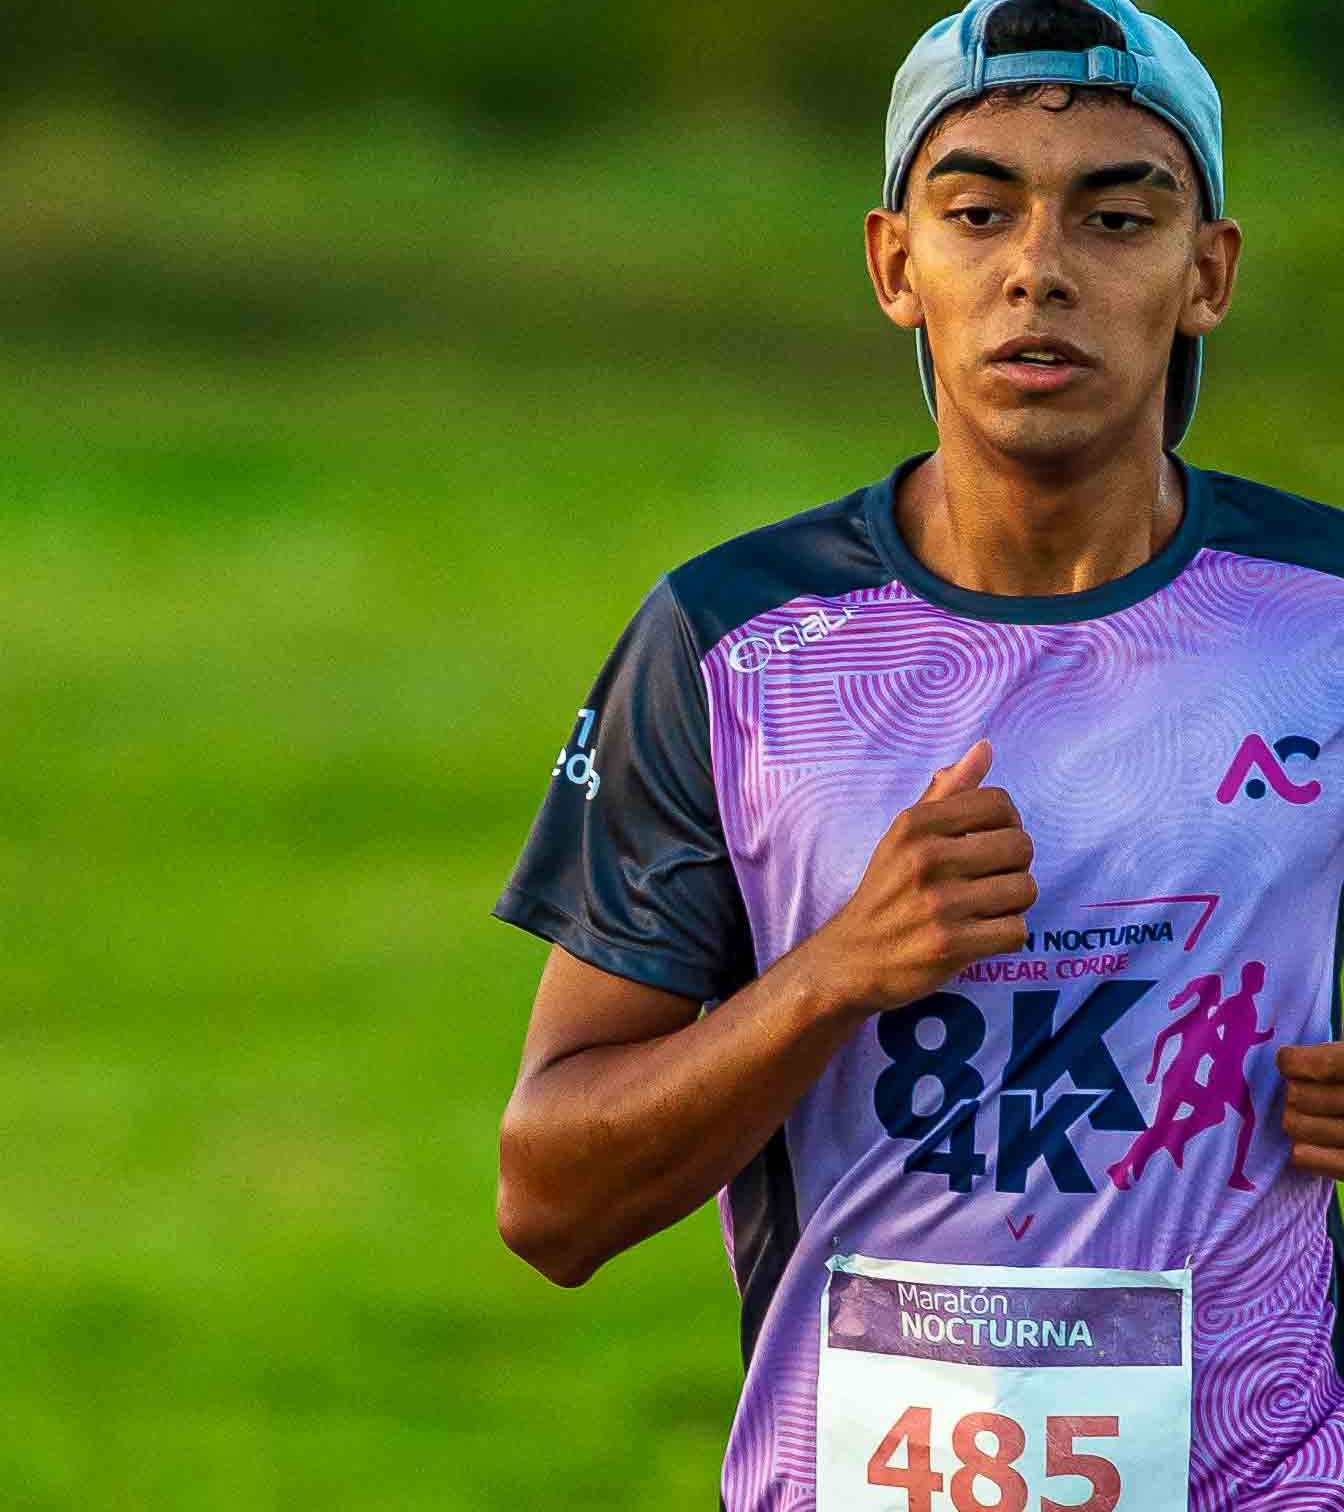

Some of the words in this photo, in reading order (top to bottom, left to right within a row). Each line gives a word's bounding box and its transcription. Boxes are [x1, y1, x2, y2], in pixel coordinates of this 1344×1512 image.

[1044, 921, 1173, 952] NOCTURNA
[958, 960, 1048, 983] ALVEAR
[1056, 952, 1129, 979] CORRE
[874, 979, 1159, 1140] 8K
[903, 1090, 1111, 1194] 4K
[897, 1283, 1008, 1315] Maratón
[900, 1311, 1093, 1347] NOCTURNA
